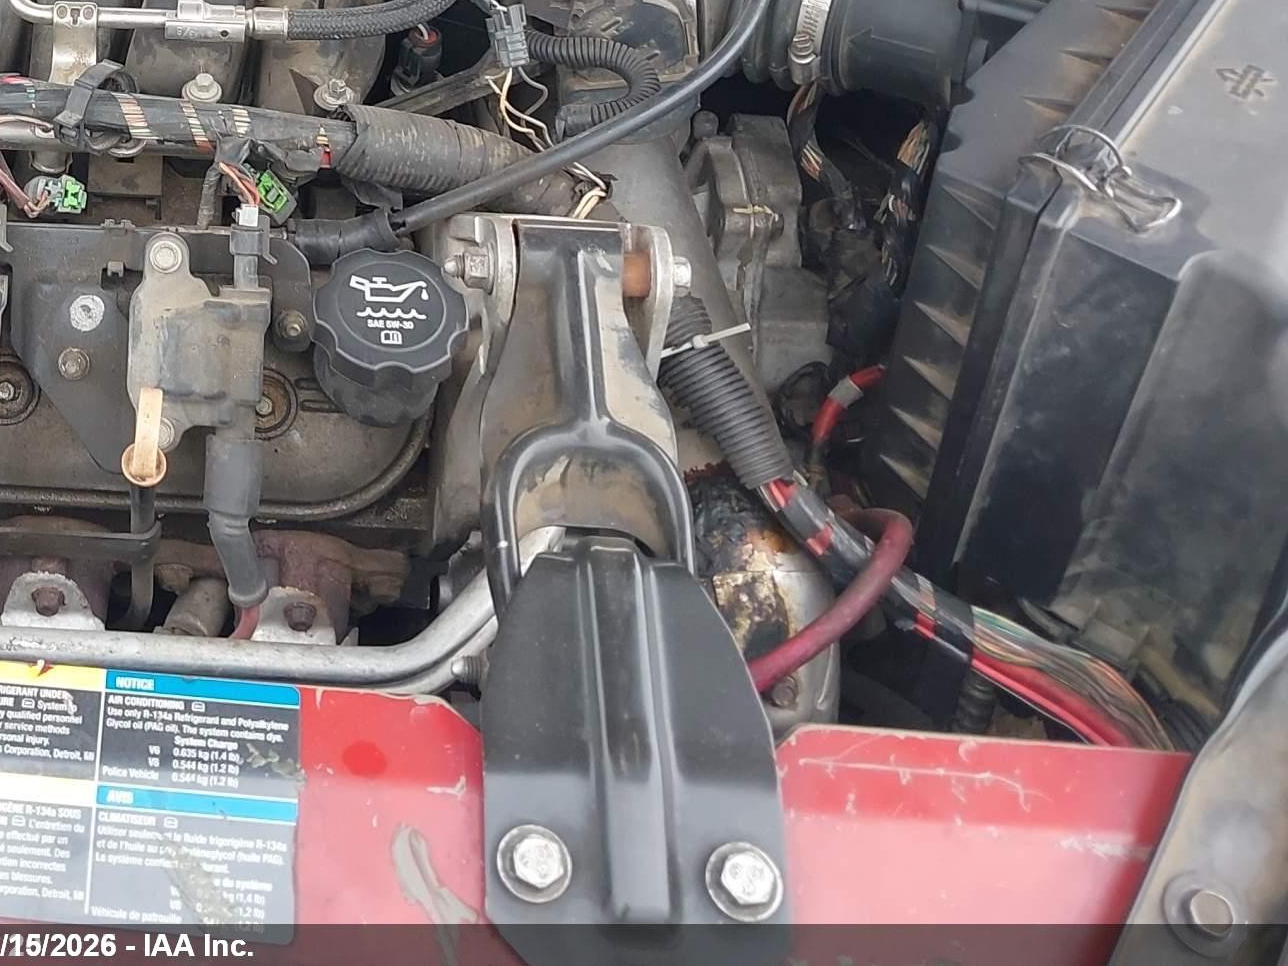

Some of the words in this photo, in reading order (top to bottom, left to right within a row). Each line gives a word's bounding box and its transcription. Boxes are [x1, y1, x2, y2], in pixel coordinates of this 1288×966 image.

[367, 319, 385, 328] SAE
[386, 320, 414, 329] 5W-30
[115, 677, 154, 691] NOTICE
[37, 700, 67, 712] System
[108, 695, 123, 705] AIR
[125, 696, 184, 710] CONDITIONING
[6, 710, 41, 723] qualified
[43, 712, 82, 724] personnel
[107, 708, 123, 716] Use
[124, 709, 142, 719] only
[143, 710, 173, 721] R-134a
[174, 713, 219, 725] Refrigerant
[221, 717, 236, 727] and
[238, 718, 289, 731] Polyalkylene
[4, 721, 33, 732] service
[35, 723, 70, 735] methods
[106, 718, 131, 730] Glycol
[132, 721, 143, 729] oil
[144, 722, 164, 732] (PAG
[182, 725, 197, 734] The
[199, 728, 228, 738] system
[230, 729, 265, 741] contains
[267, 732, 283, 742] dye.
[174, 735, 206, 748] System
[207, 738, 238, 750] Charge
[53, 749, 82, 761] Detroit,
[84, 752, 95, 762] MI
[198, 748, 209, 761] kg
[173, 759, 195, 770] 0.544
[197, 761, 208, 773] kg
[103, 766, 128, 778] Police
[129, 769, 159, 780] Vehicle
[197, 775, 208, 785] kg
[107, 790, 134, 804] AVIS
[25, 805, 57, 817] R-134a
[58, 808, 82, 819] SOUS
[98, 812, 156, 827] CLIMATISEUR
[74, 823, 85, 833] du
[41, 834, 56, 844] par
[57, 836, 68, 844] un
[96, 840, 105, 849] et
[107, 840, 118, 850] de
[147, 844, 158, 852] au
[184, 833, 207, 845] fluide
[54, 848, 70, 858] Des
[96, 852, 106, 861] Le
[129, 910, 140, 920] de
